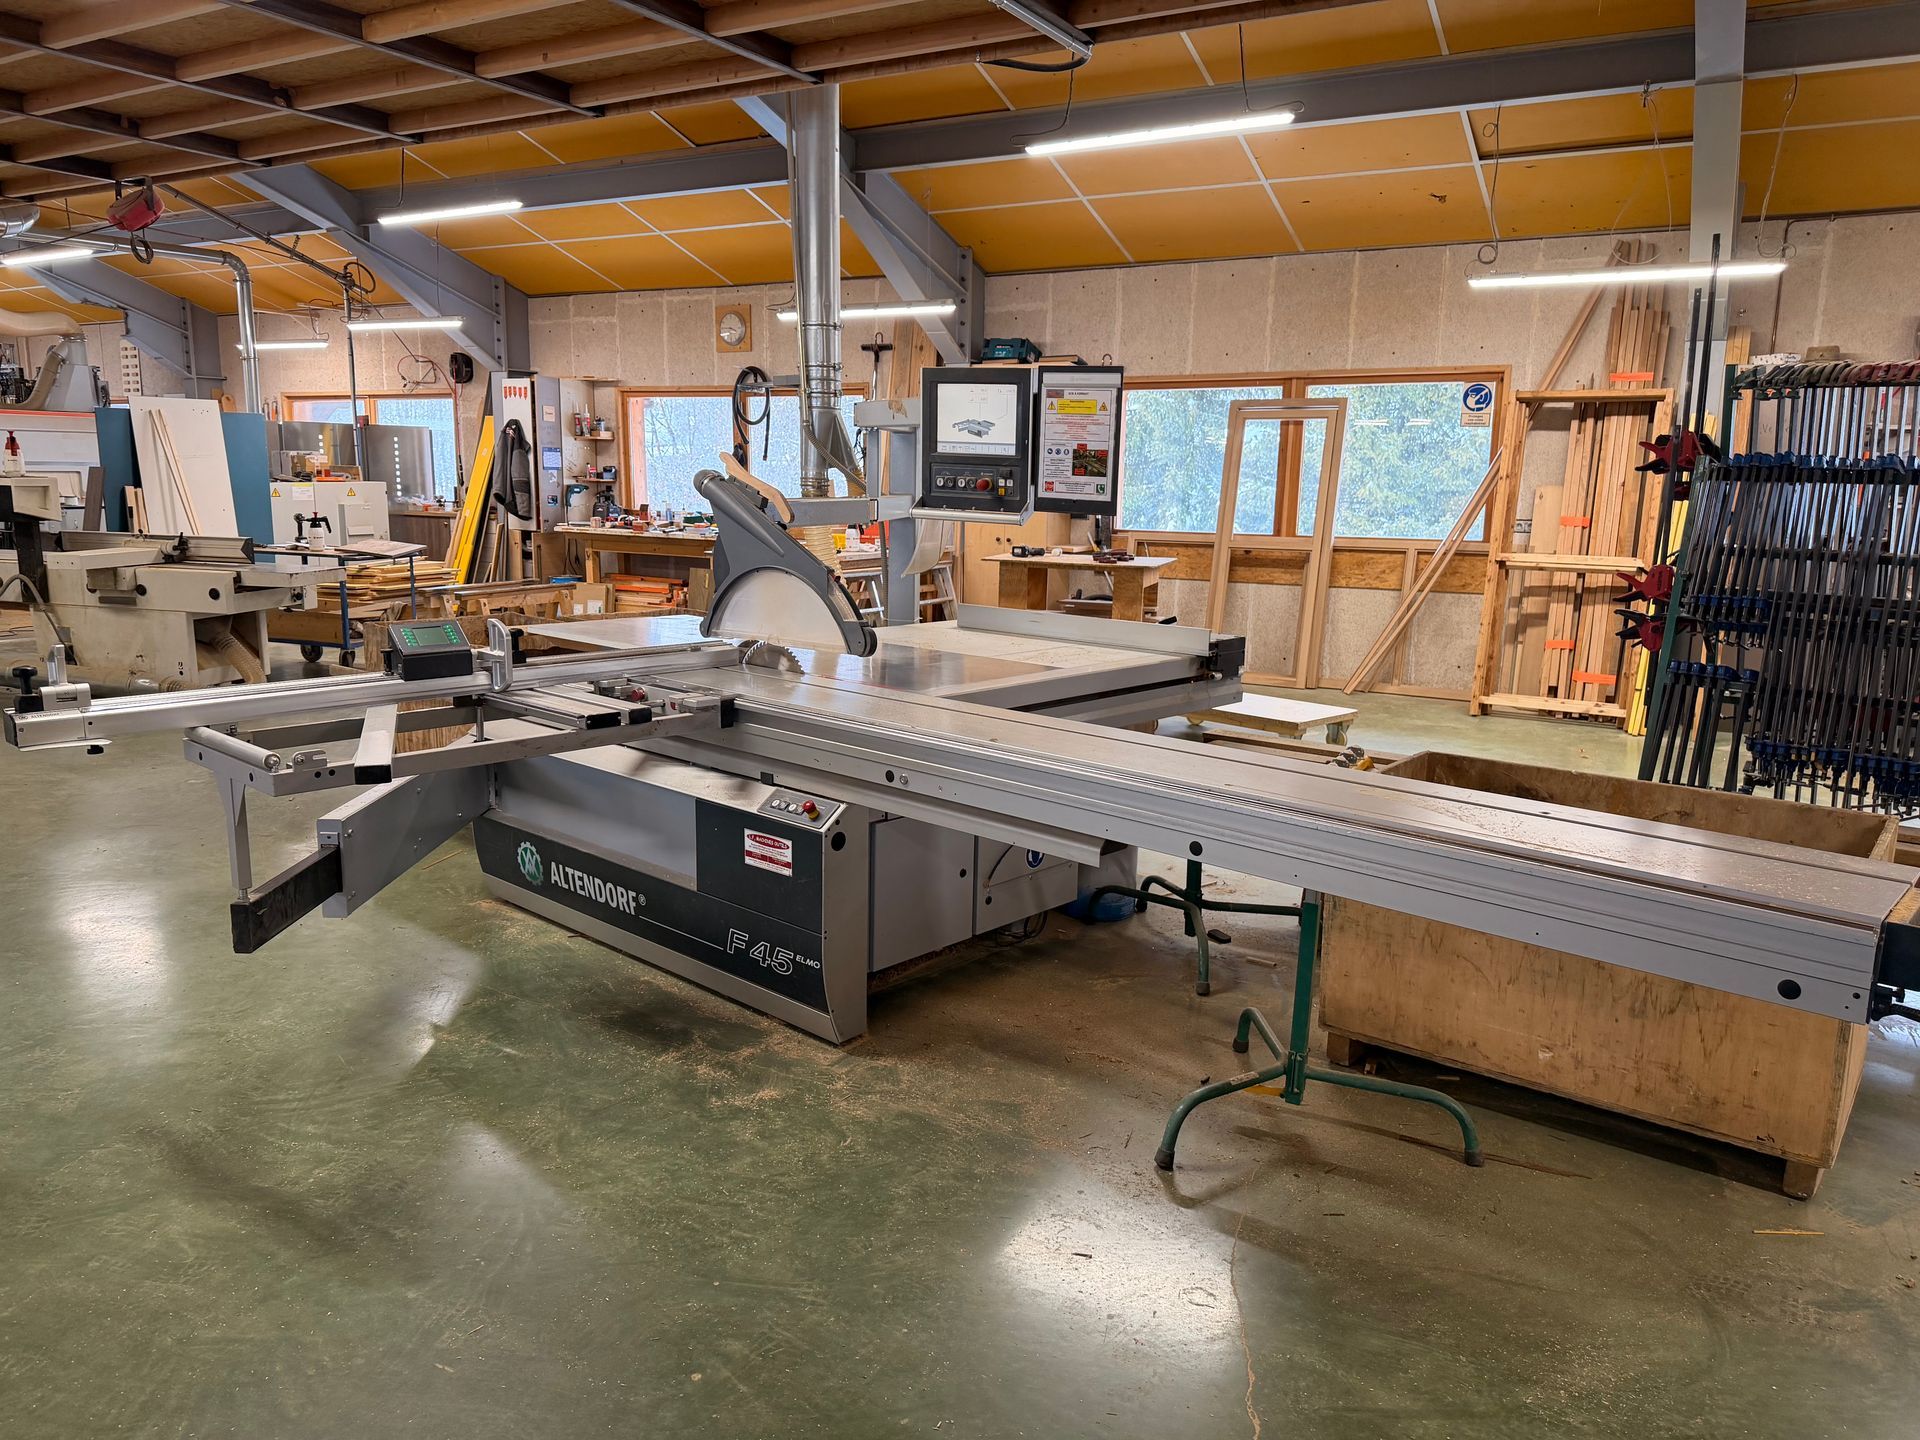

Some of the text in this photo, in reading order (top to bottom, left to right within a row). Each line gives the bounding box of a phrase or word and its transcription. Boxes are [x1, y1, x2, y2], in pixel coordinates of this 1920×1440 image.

[727, 928, 821, 975] F 45 ELMO
